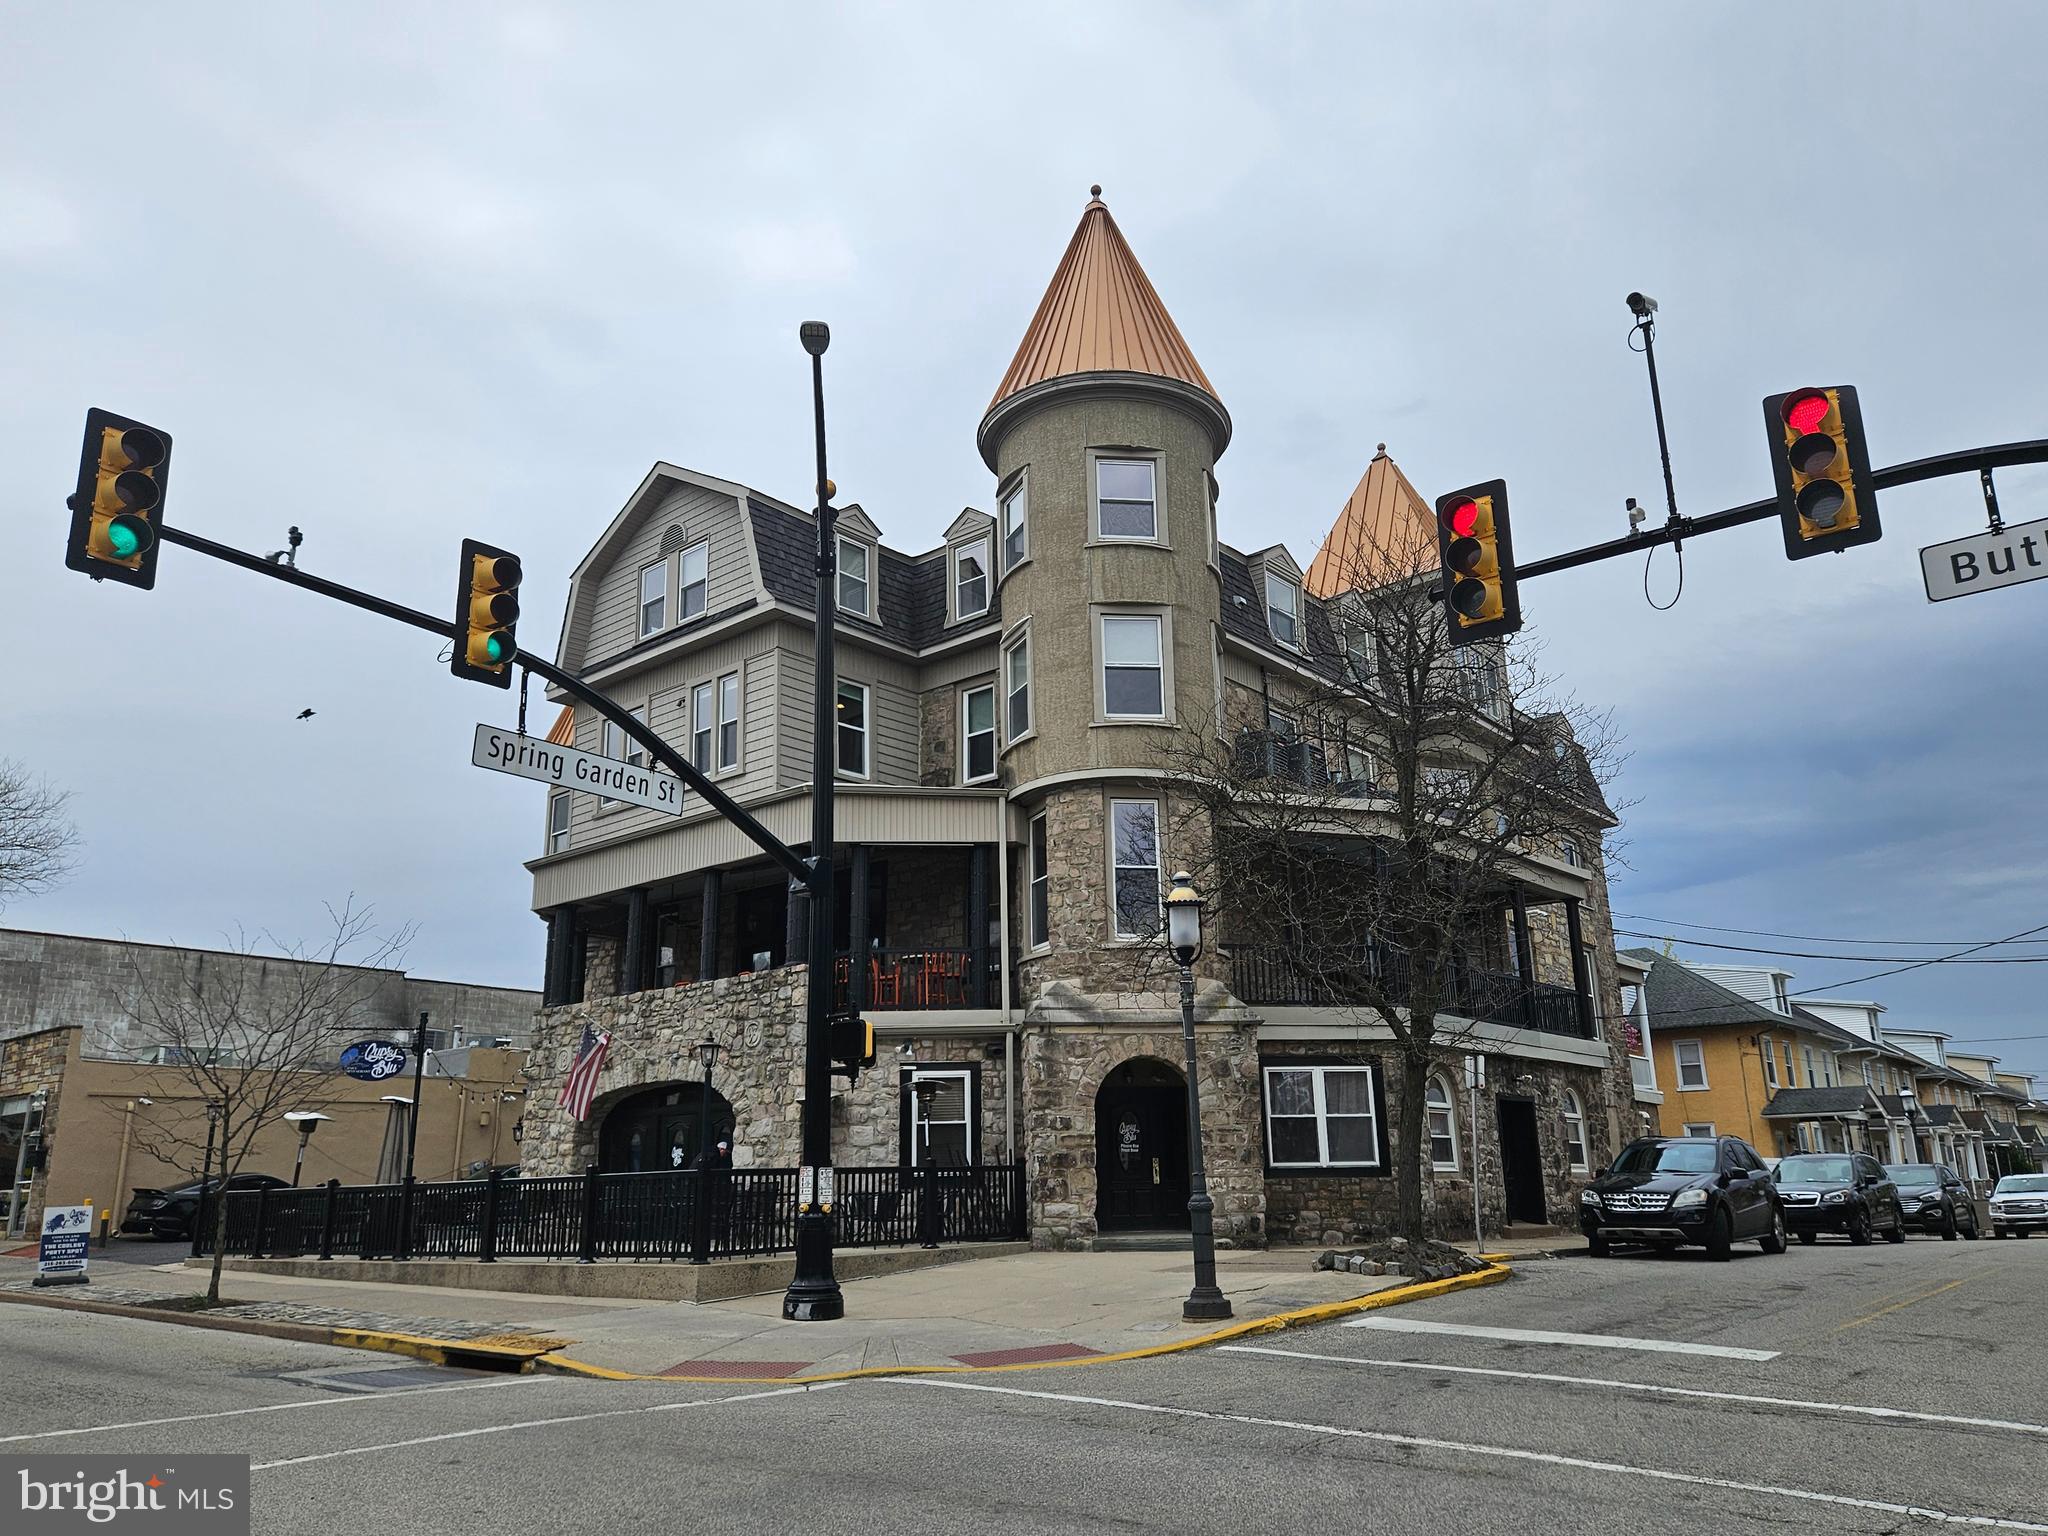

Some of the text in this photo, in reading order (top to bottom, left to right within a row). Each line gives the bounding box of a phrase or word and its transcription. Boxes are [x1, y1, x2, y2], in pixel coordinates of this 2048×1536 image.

[1950, 530, 2048, 584] But
[487, 735, 676, 804] Spring Garden St
[364, 1042, 404, 1062] Gypsy
[371, 1059, 398, 1078] Blu
